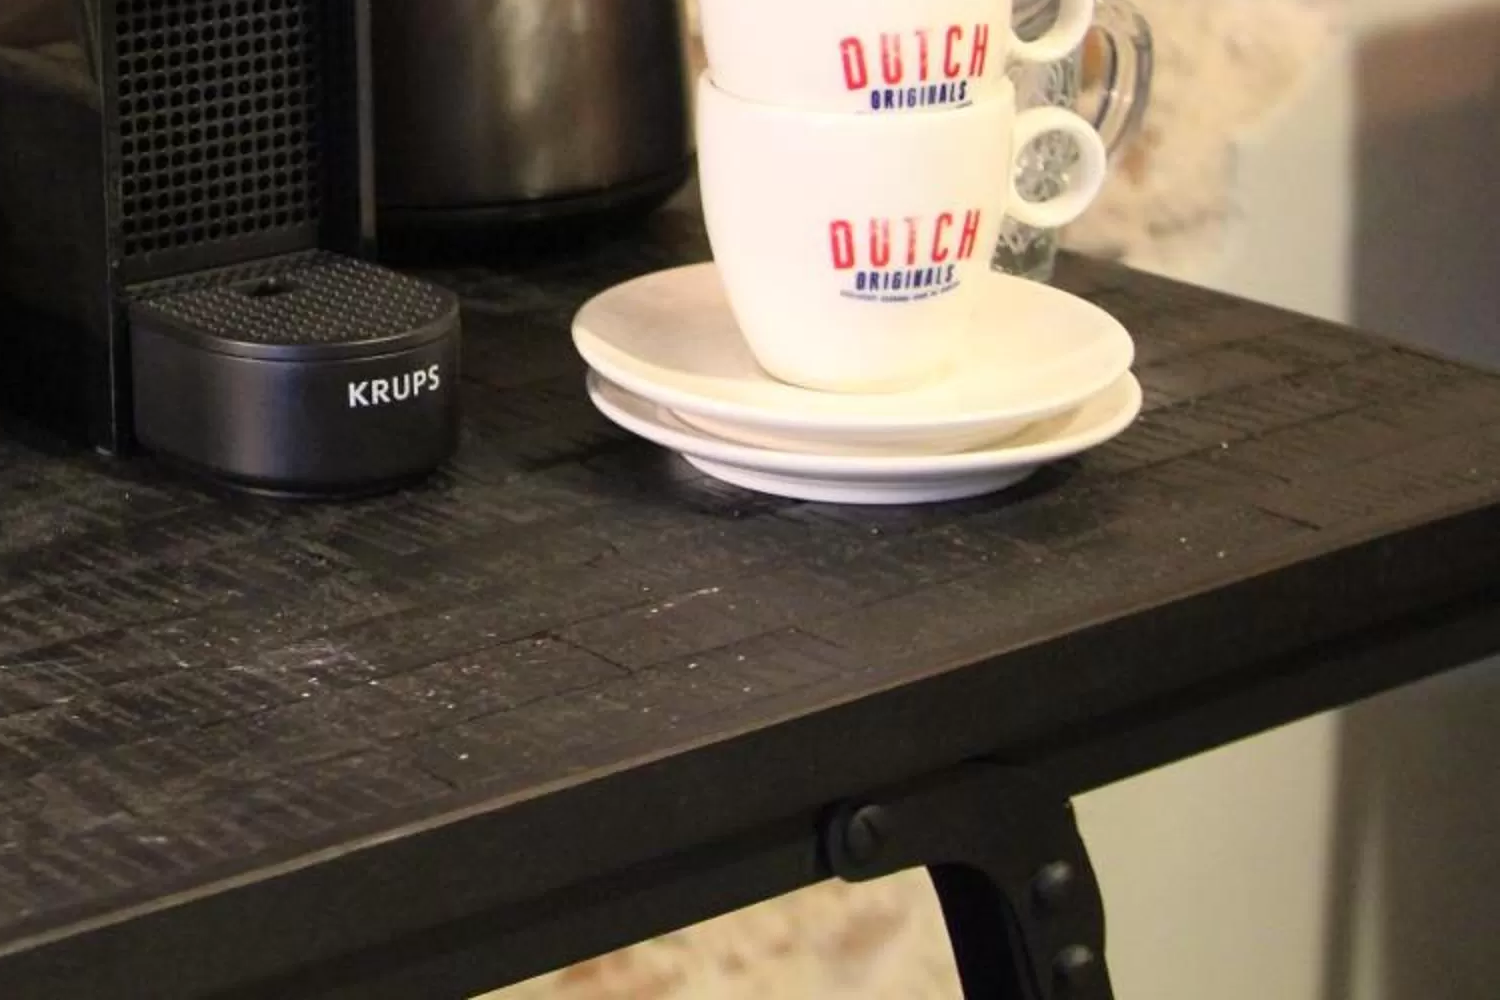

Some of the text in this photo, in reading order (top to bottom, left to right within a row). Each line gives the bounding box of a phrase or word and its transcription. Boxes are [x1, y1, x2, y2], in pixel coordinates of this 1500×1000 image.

[839, 23, 989, 91] DUTCH
[870, 80, 968, 110] ORIGINALS
[828, 209, 981, 270] DUTCH
[855, 264, 956, 291] ORIGINALS
[348, 364, 440, 408] KRUPS
